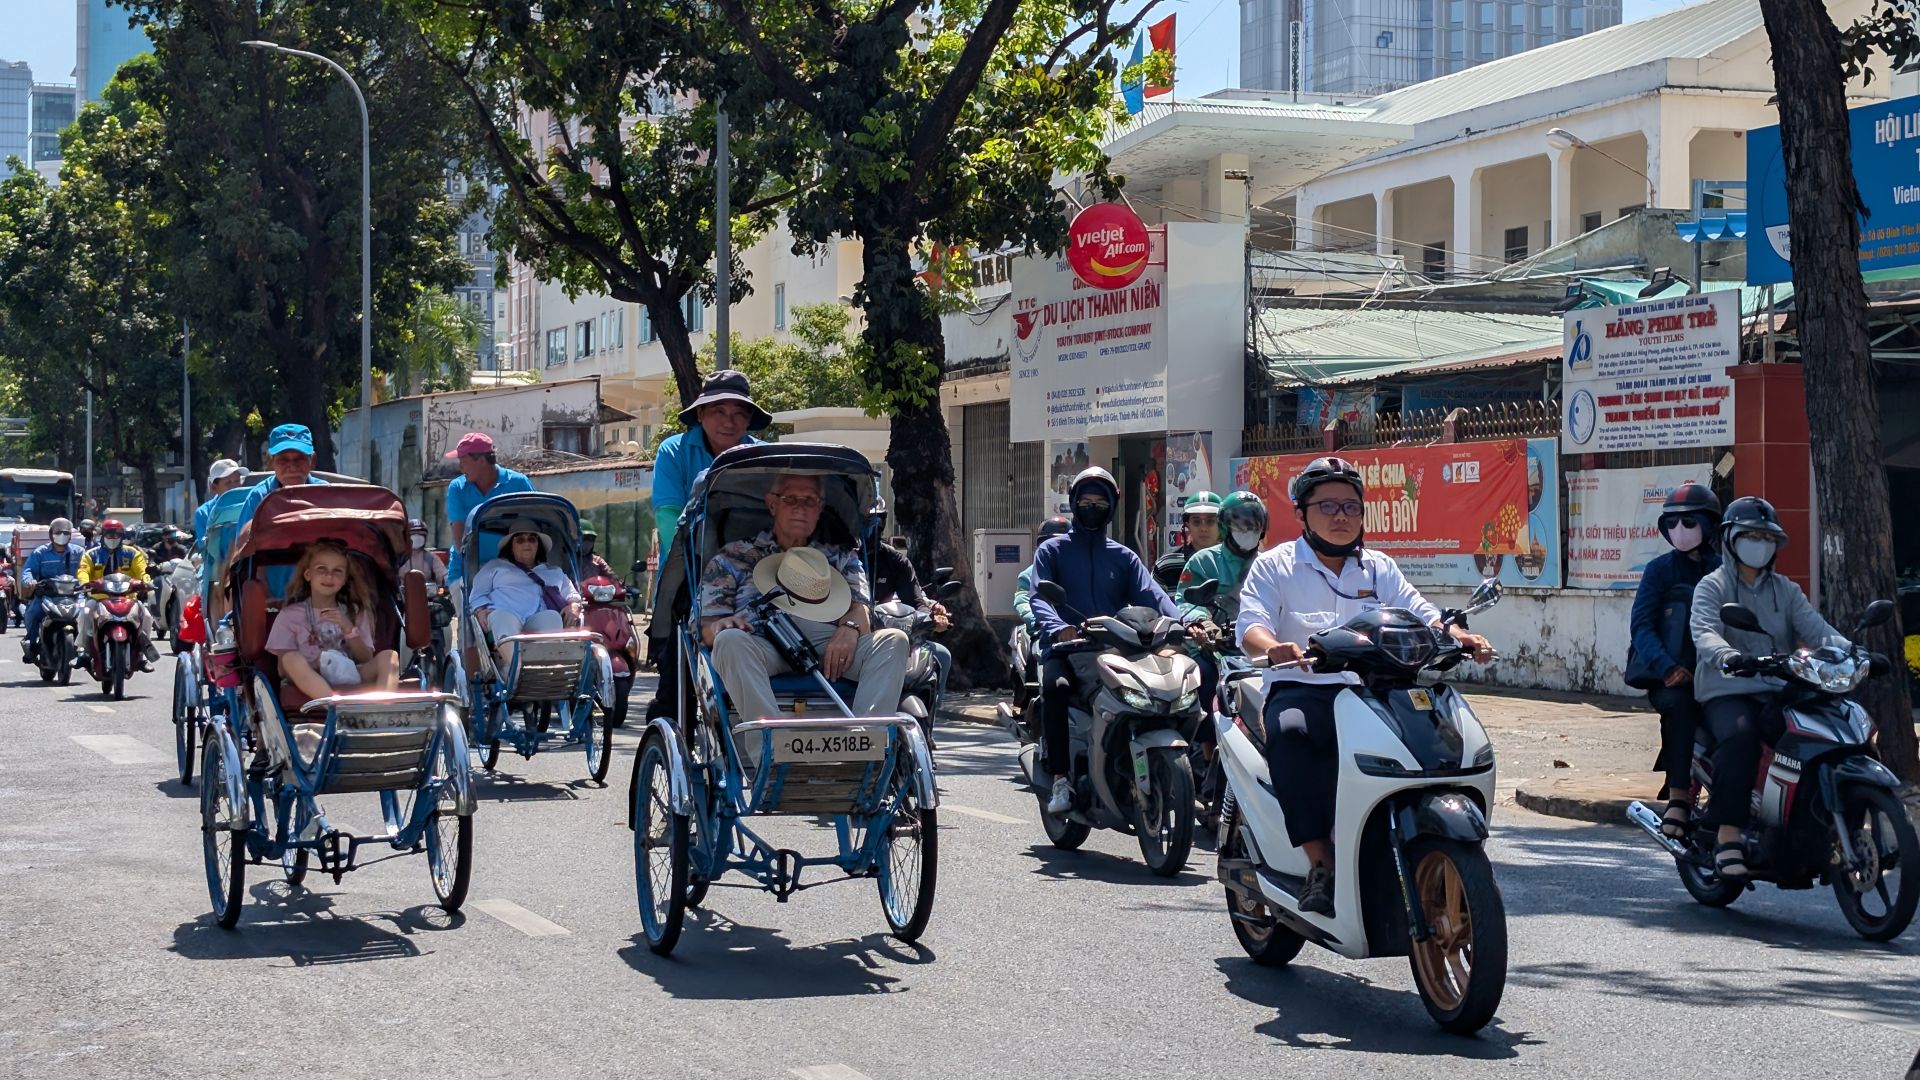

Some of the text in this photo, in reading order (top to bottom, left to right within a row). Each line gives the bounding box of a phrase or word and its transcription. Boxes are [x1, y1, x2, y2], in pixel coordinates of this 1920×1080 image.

[1876, 112, 1901, 148] HỘI
[1104, 242, 1144, 258] Air.com
[1018, 298, 1036, 310] YTC
[1044, 278, 1160, 330] DU LỊCH THANH NIÊN
[1605, 304, 1718, 338] HÃNG PHIM TRẺ
[1056, 336, 1072, 348] YOUTH
[1125, 322, 1152, 337] COMPANY
[1638, 332, 1685, 346] YOUTH FILMS
[1616, 380, 1633, 390] THÀNH
[1667, 374, 1678, 386] PHỐ
[1368, 457, 1406, 488] SẺ CHIA
[1643, 488, 1663, 498] THANH
[1392, 490, 1418, 533] ĐẦY
[1603, 523, 1626, 542] THIỆU
[1642, 522, 1659, 538] LÀM
[1600, 550, 1621, 560] 2025
[792, 736, 870, 754] Q4-X518.B
[1774, 752, 1801, 770] YAMAHA
